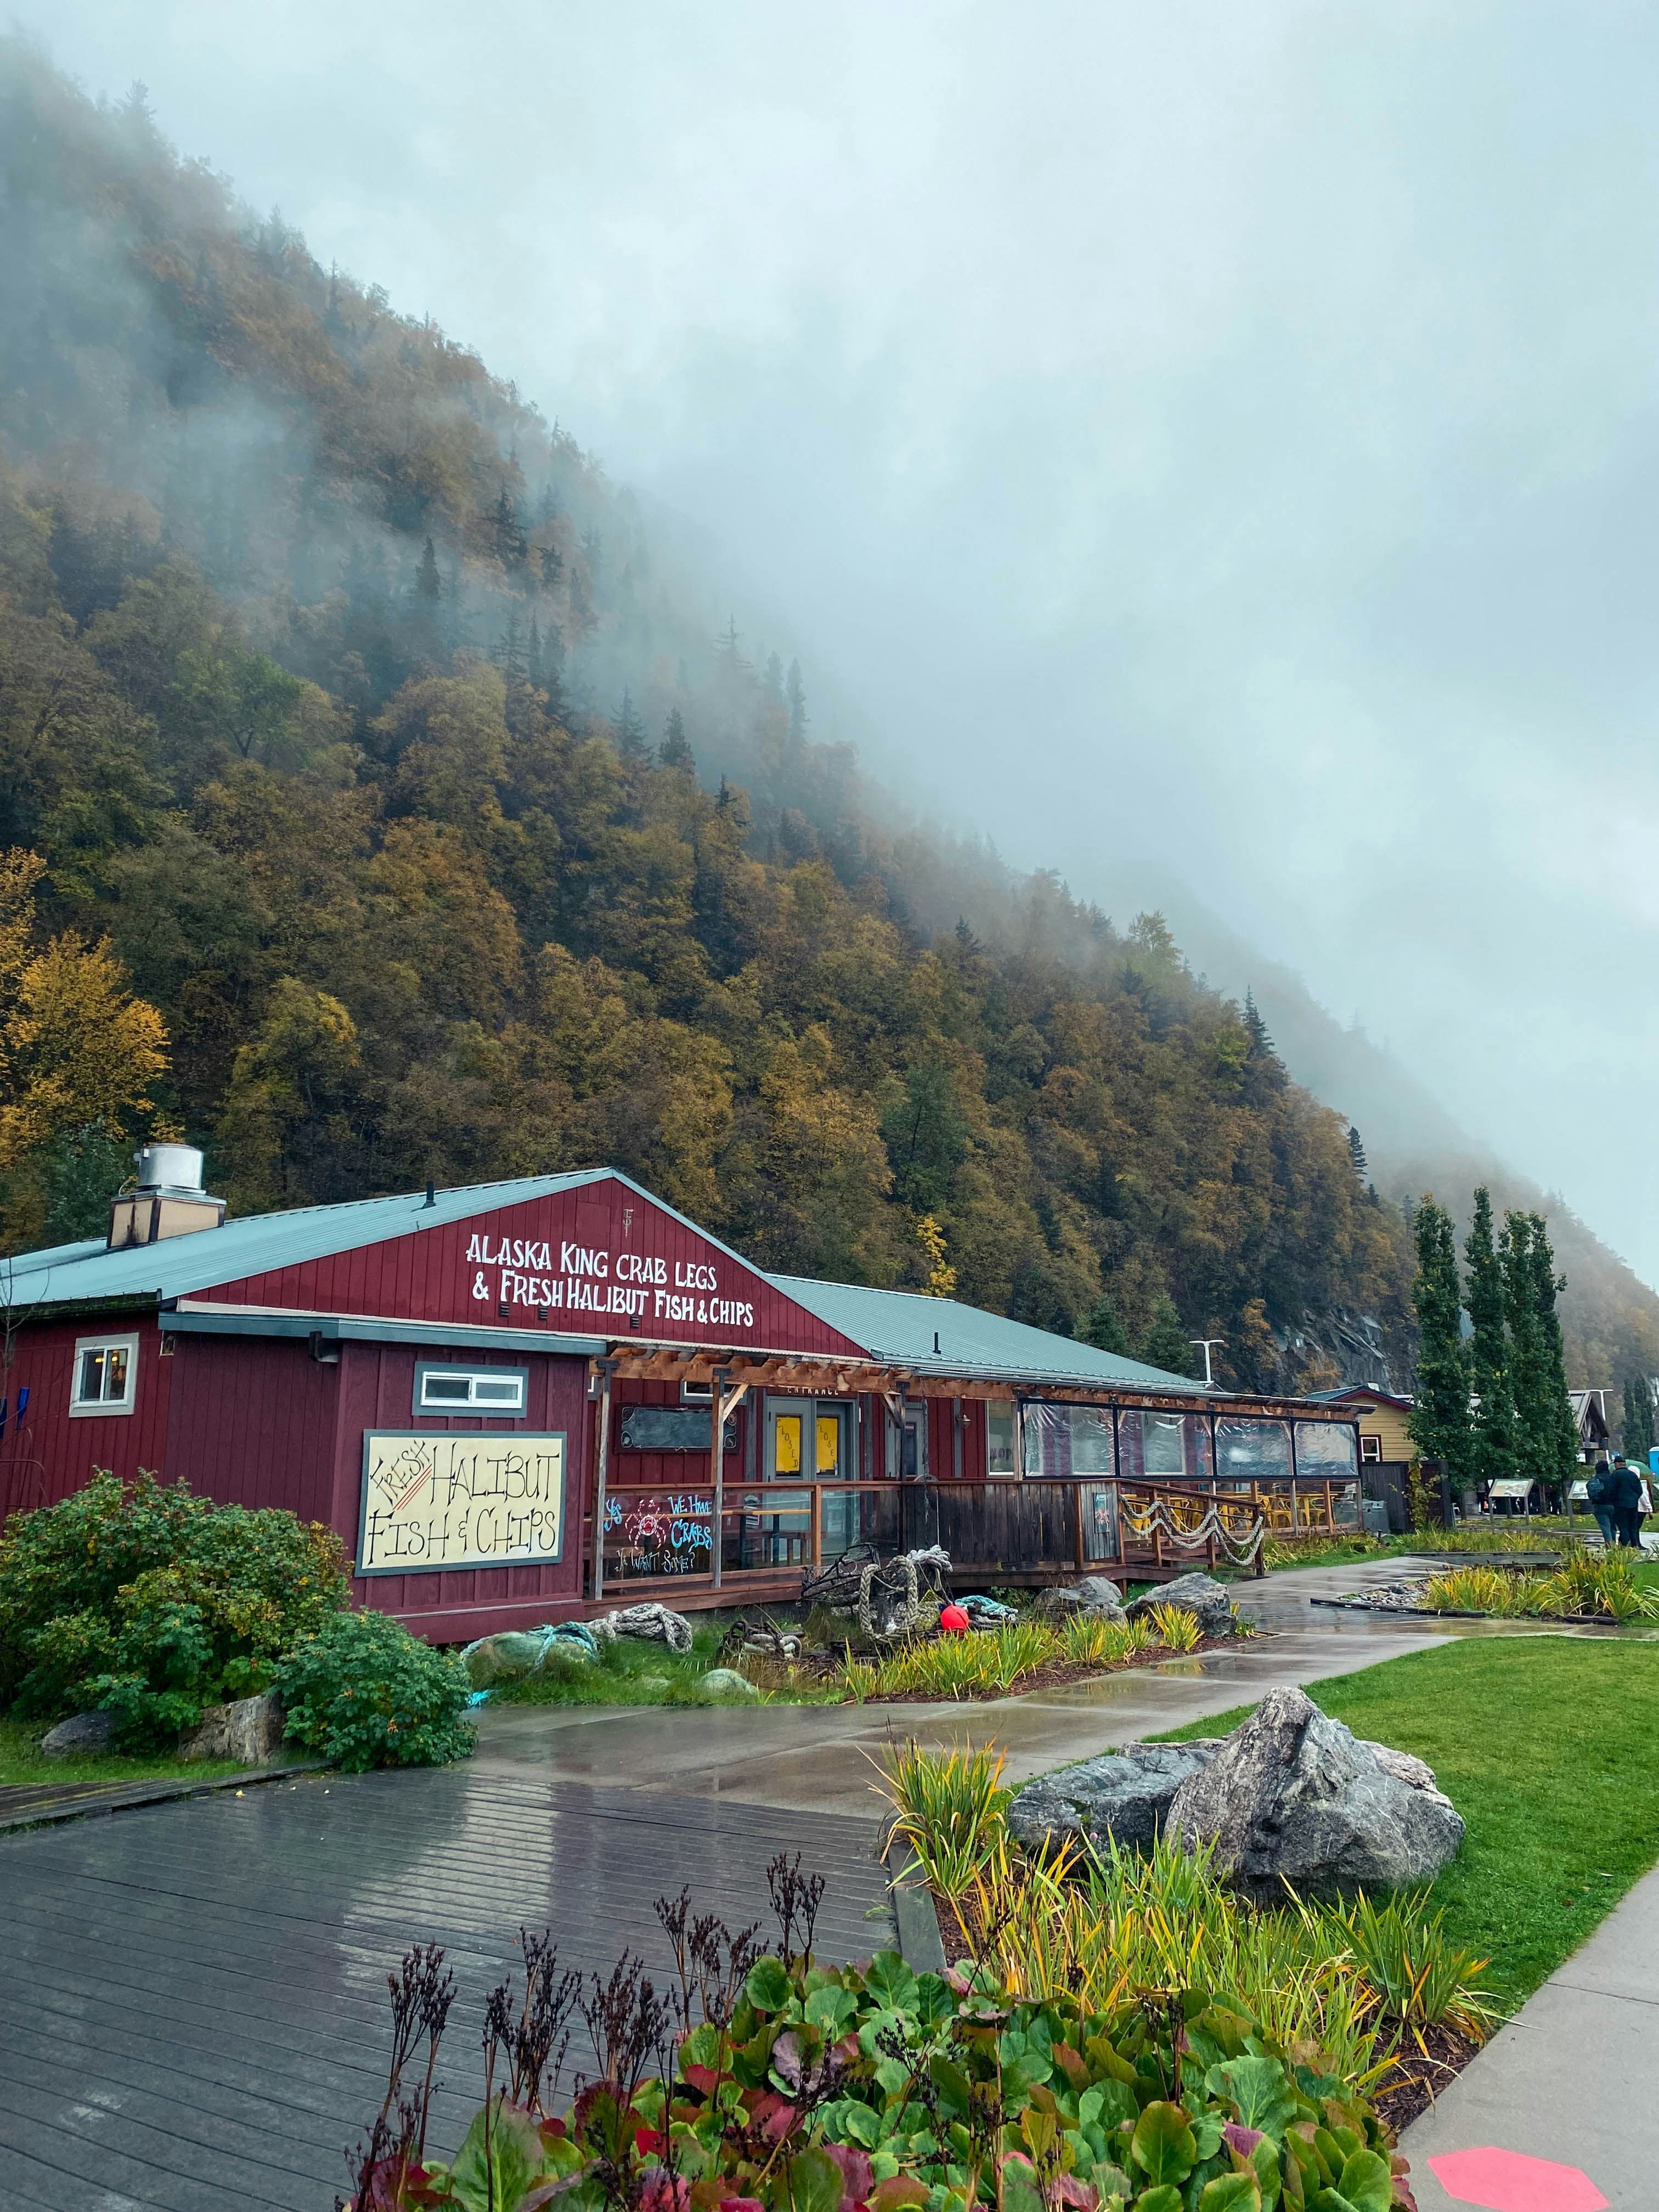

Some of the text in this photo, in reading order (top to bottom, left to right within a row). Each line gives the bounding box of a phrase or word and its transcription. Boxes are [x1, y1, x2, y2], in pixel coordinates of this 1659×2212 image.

[465, 1234, 552, 1271] ALASKA
[560, 1241, 608, 1278] KING
[616, 1254, 668, 1285] CRAB
[472, 1269, 754, 1327] & FRESH HALIBUT FISH & CHIPS
[370, 1440, 430, 1505] FRESH
[430, 1441, 560, 1507] HALIBUT
[368, 1506, 556, 1566] FISH & CHIPS
[629, 1548, 659, 1572] WANT
[662, 1549, 695, 1573] SOME?
[671, 1518, 713, 1553] CRABS
